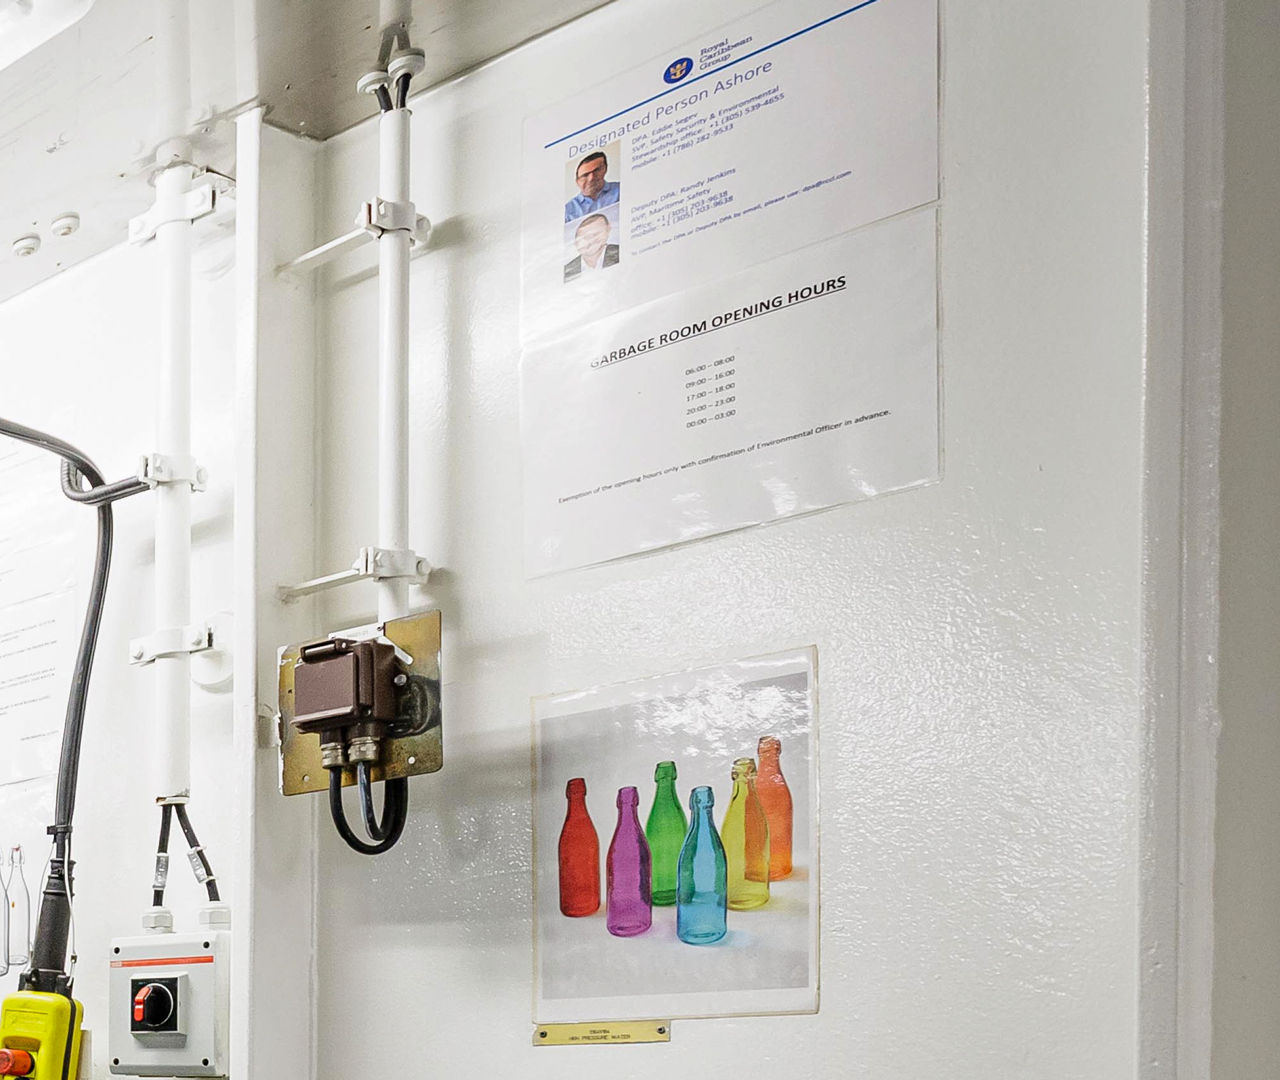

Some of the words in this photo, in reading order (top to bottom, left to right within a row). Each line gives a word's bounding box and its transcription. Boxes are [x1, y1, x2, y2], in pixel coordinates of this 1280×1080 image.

[699, 36, 753, 63] Caribbean
[700, 38, 729, 56] Royal
[699, 53, 731, 71] Group
[568, 112, 651, 158] Designated
[656, 89, 708, 120] Person
[713, 62, 773, 94] Ashore
[650, 131, 674, 146] Safety
[675, 118, 707, 135] Security
[709, 112, 716, 120] &
[717, 85, 780, 116] Environmental
[631, 139, 679, 162] Stewardship
[686, 188, 711, 201] Safety
[590, 337, 656, 370] GARBAGE
[659, 320, 708, 346] ROOM
[711, 295, 784, 328] OPENING
[787, 275, 847, 304] HOURS
[685, 364, 706, 376] 06:00
[685, 377, 706, 389] 09:00
[686, 391, 707, 402] 17:00
[686, 404, 707, 415] 20:00
[686, 417, 707, 428] 00:00
[642, 471, 662, 480] hours
[663, 466, 679, 475] only
[680, 461, 696, 469] with
[698, 448, 745, 465] confirmation
[747, 444, 755, 452] of
[756, 429, 814, 450] Environmental
[815, 421, 843, 434] Officer
[844, 418, 852, 426] in
[854, 410, 892, 425] advance.
